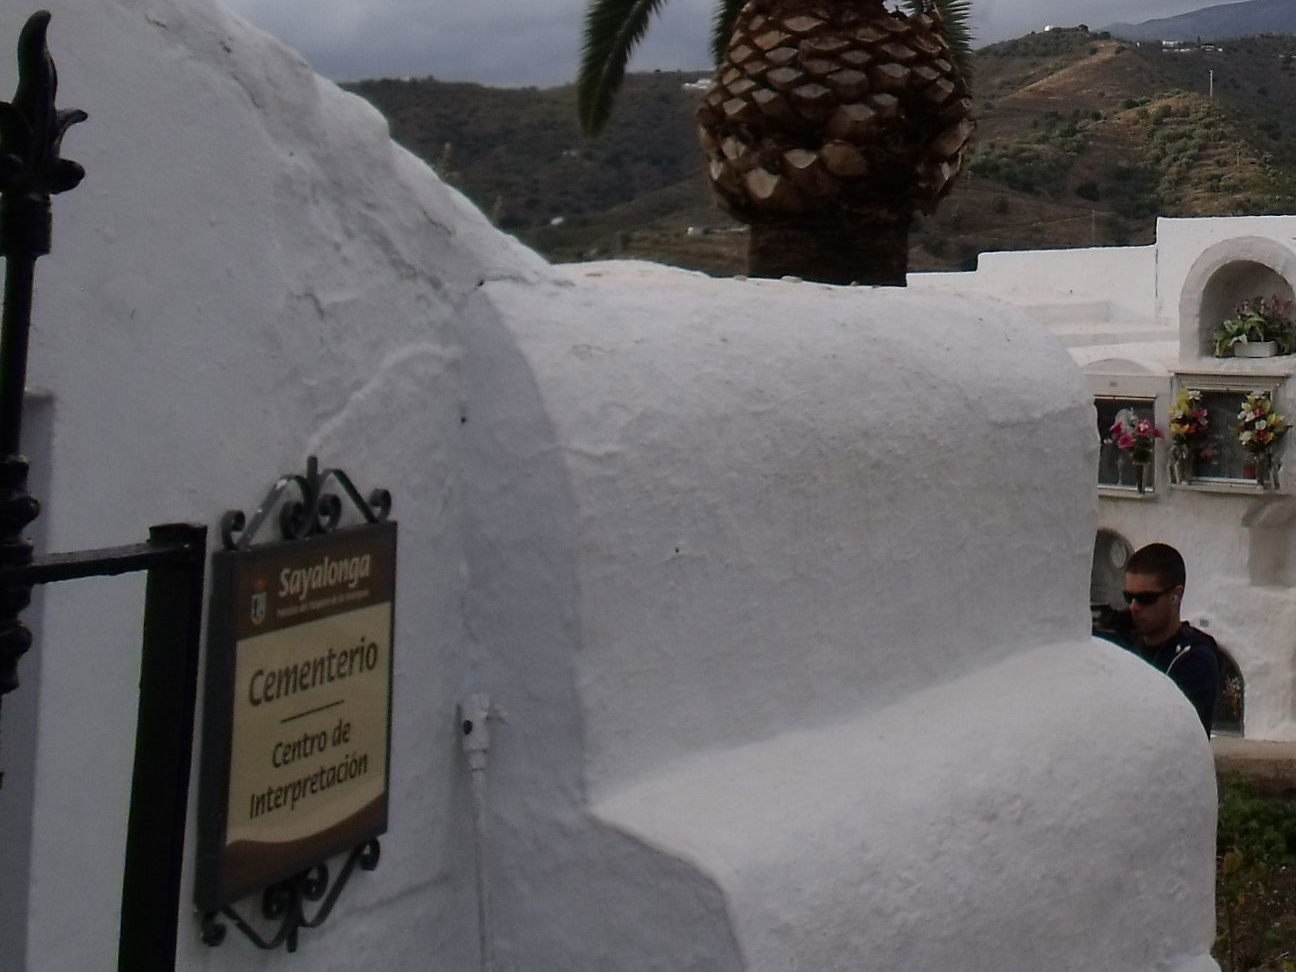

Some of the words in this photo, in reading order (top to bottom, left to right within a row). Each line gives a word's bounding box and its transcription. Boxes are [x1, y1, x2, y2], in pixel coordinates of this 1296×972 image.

[280, 554, 370, 600] Sayalonga
[249, 637, 378, 706] Cementerio
[272, 731, 326, 768] Centro
[332, 719, 351, 747] de
[249, 752, 368, 819] Interpretación
